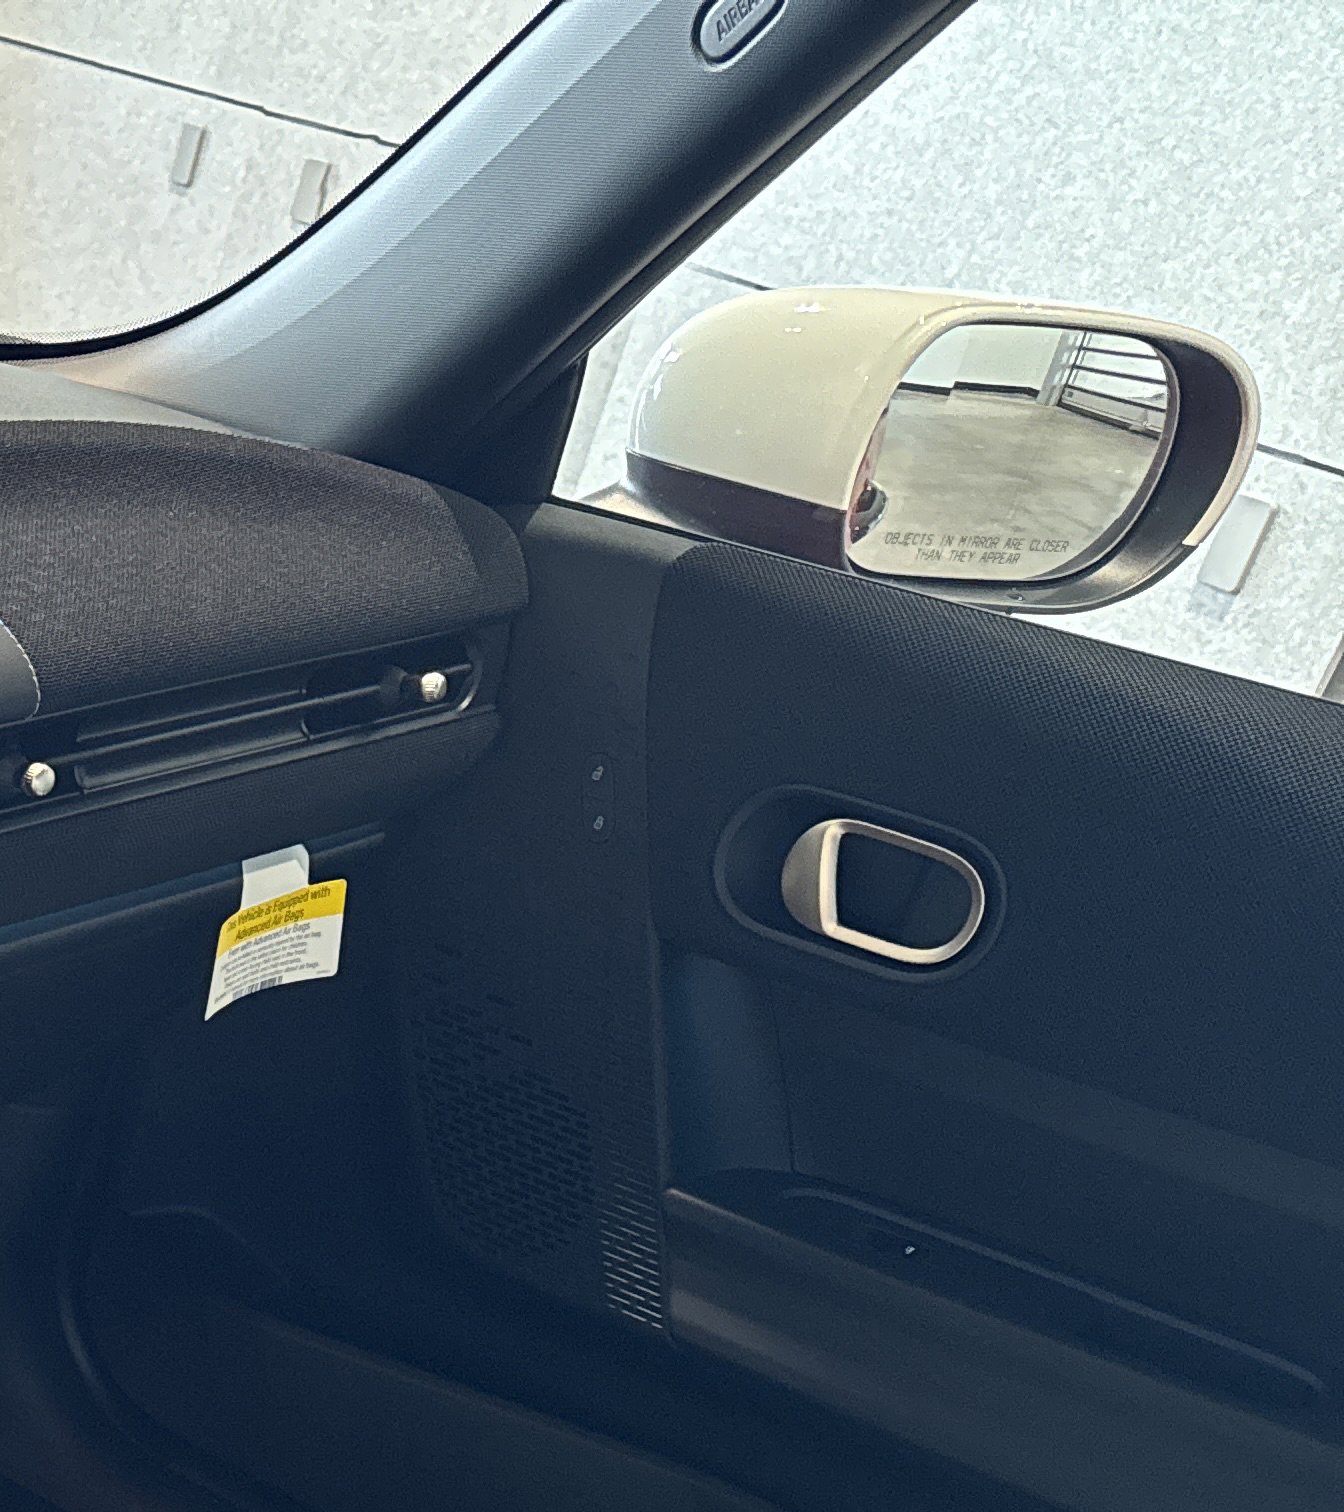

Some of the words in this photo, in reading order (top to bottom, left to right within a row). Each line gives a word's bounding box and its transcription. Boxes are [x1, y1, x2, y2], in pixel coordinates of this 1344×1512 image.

[884, 531, 935, 547] OBJECTS
[939, 534, 955, 548] IN
[958, 535, 1001, 550] MIRROR
[1003, 537, 1027, 551] ARE
[1029, 539, 1070, 553] CLOSER
[915, 547, 942, 561] THAN
[949, 549, 976, 563] THEY
[978, 550, 1022, 565] APPEAR
[310, 886, 331, 900] with
[235, 919, 271, 941] Advanced
